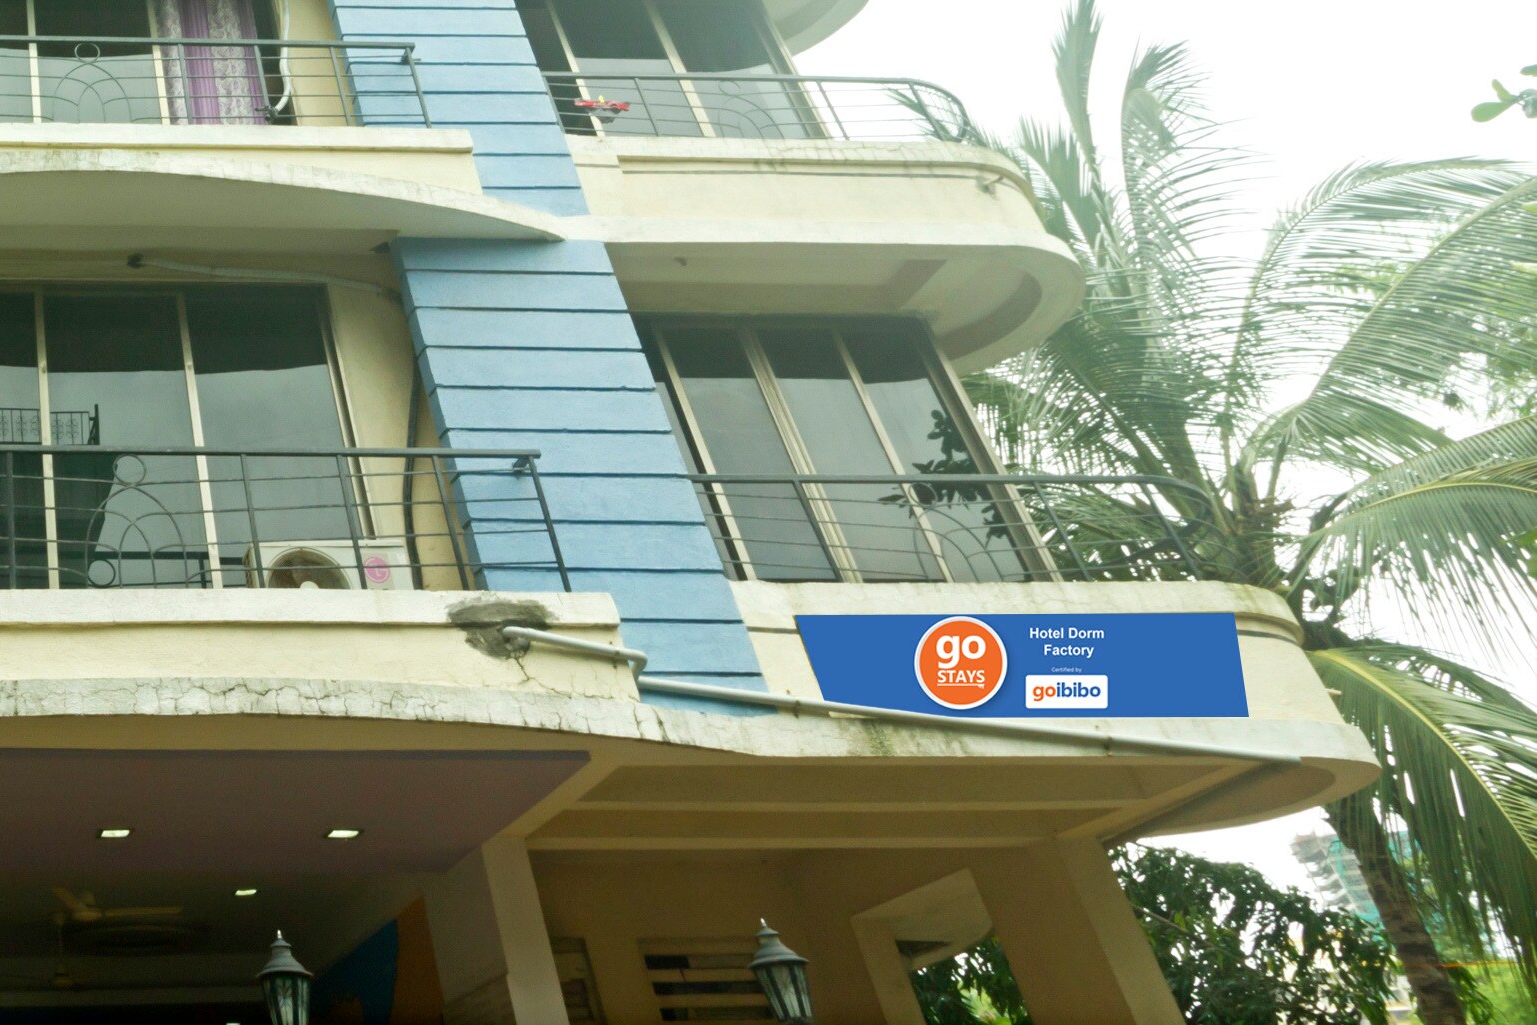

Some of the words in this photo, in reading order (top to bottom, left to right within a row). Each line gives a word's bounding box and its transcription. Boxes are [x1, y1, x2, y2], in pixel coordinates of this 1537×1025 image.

[1029, 627, 1064, 639] Hotel
[1068, 627, 1105, 639] Dorm
[936, 635, 986, 669] go
[1044, 644, 1094, 658] Factory
[937, 670, 985, 683] STAYS
[1032, 682, 1101, 702] goibibo
